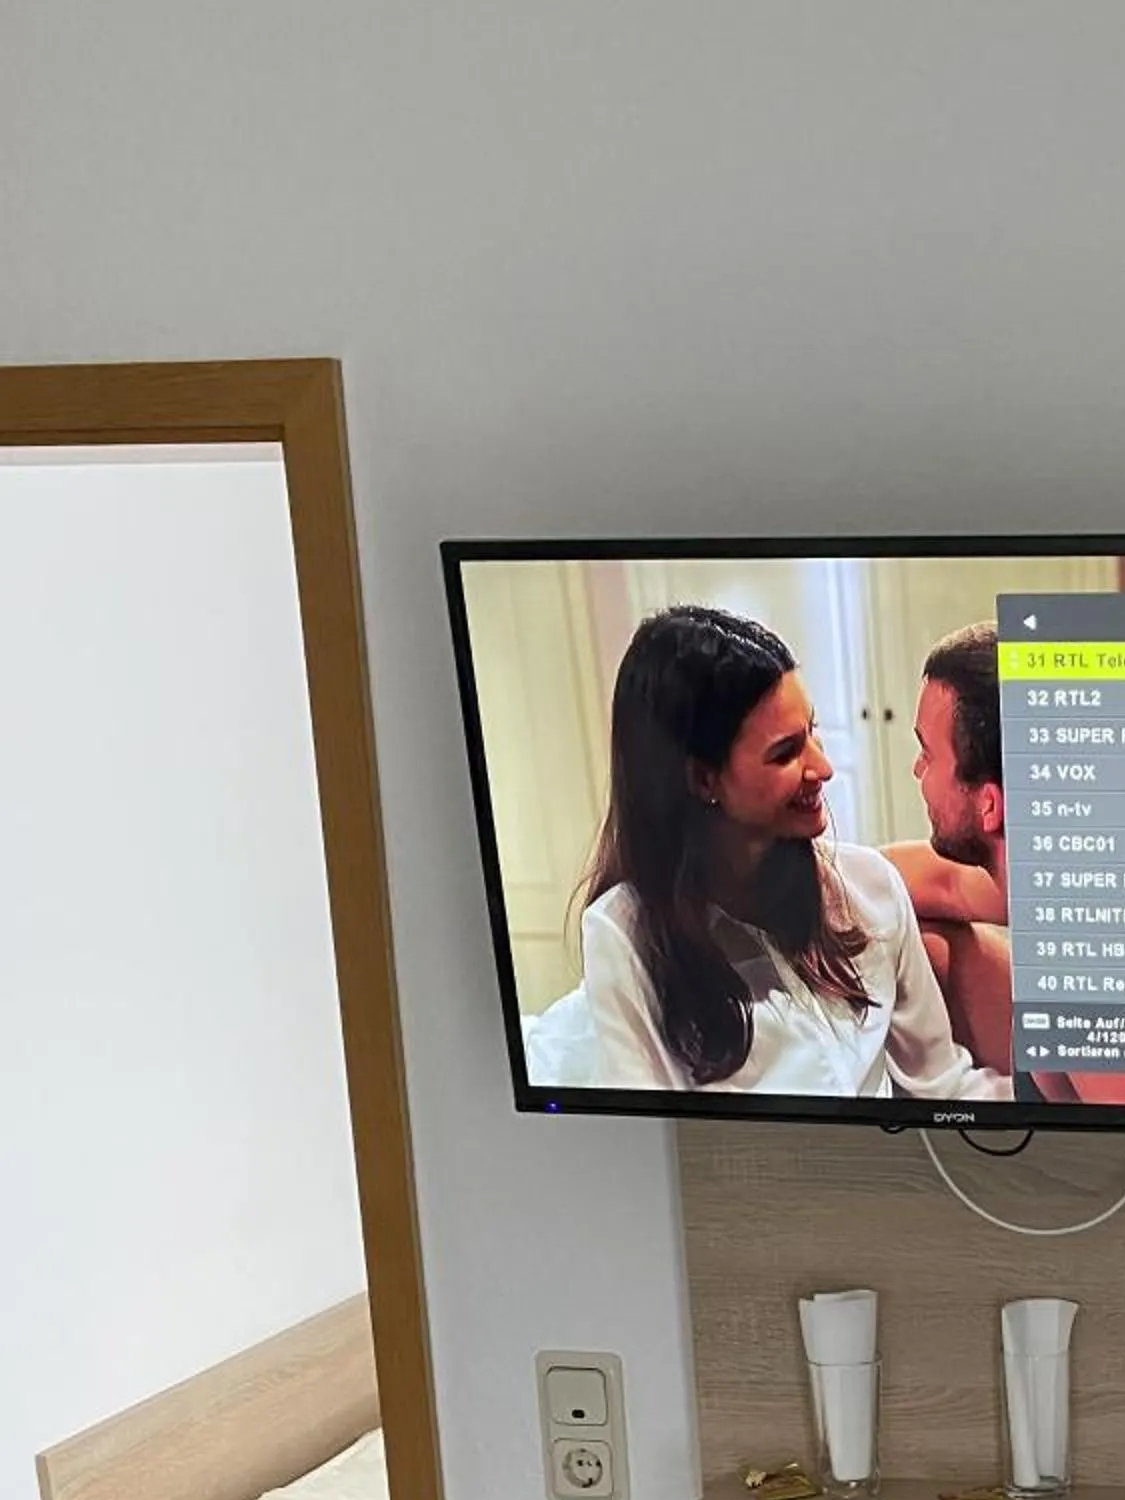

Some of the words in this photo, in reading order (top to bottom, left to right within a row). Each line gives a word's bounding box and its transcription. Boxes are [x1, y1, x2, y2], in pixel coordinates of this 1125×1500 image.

[1027, 653, 1046, 668] 31
[1053, 653, 1088, 668] RTL
[1027, 690, 1049, 706] 32
[1055, 690, 1101, 707] RTL2
[1028, 728, 1049, 744] 33
[1055, 728, 1114, 744] SUPER
[1029, 765, 1051, 781] 34
[1056, 765, 1096, 781] VOX
[1031, 801, 1052, 817] 35
[1057, 802, 1092, 817] n-tv
[1033, 836, 1053, 852] 36
[1059, 836, 1115, 852] CBC01
[1033, 873, 1053, 889] 37
[1060, 873, 1116, 889] SUPER
[1035, 908, 1055, 922] 38
[1036, 942, 1056, 957] 39
[1062, 942, 1097, 957] RTL
[1102, 943, 1125, 958] HB
[1037, 976, 1057, 990] 40
[1063, 976, 1098, 991] RTL
[1057, 1016, 1091, 1029] Seite
[1057, 1044, 1119, 1058] Sortieren
[933, 1112, 975, 1123] DYON
